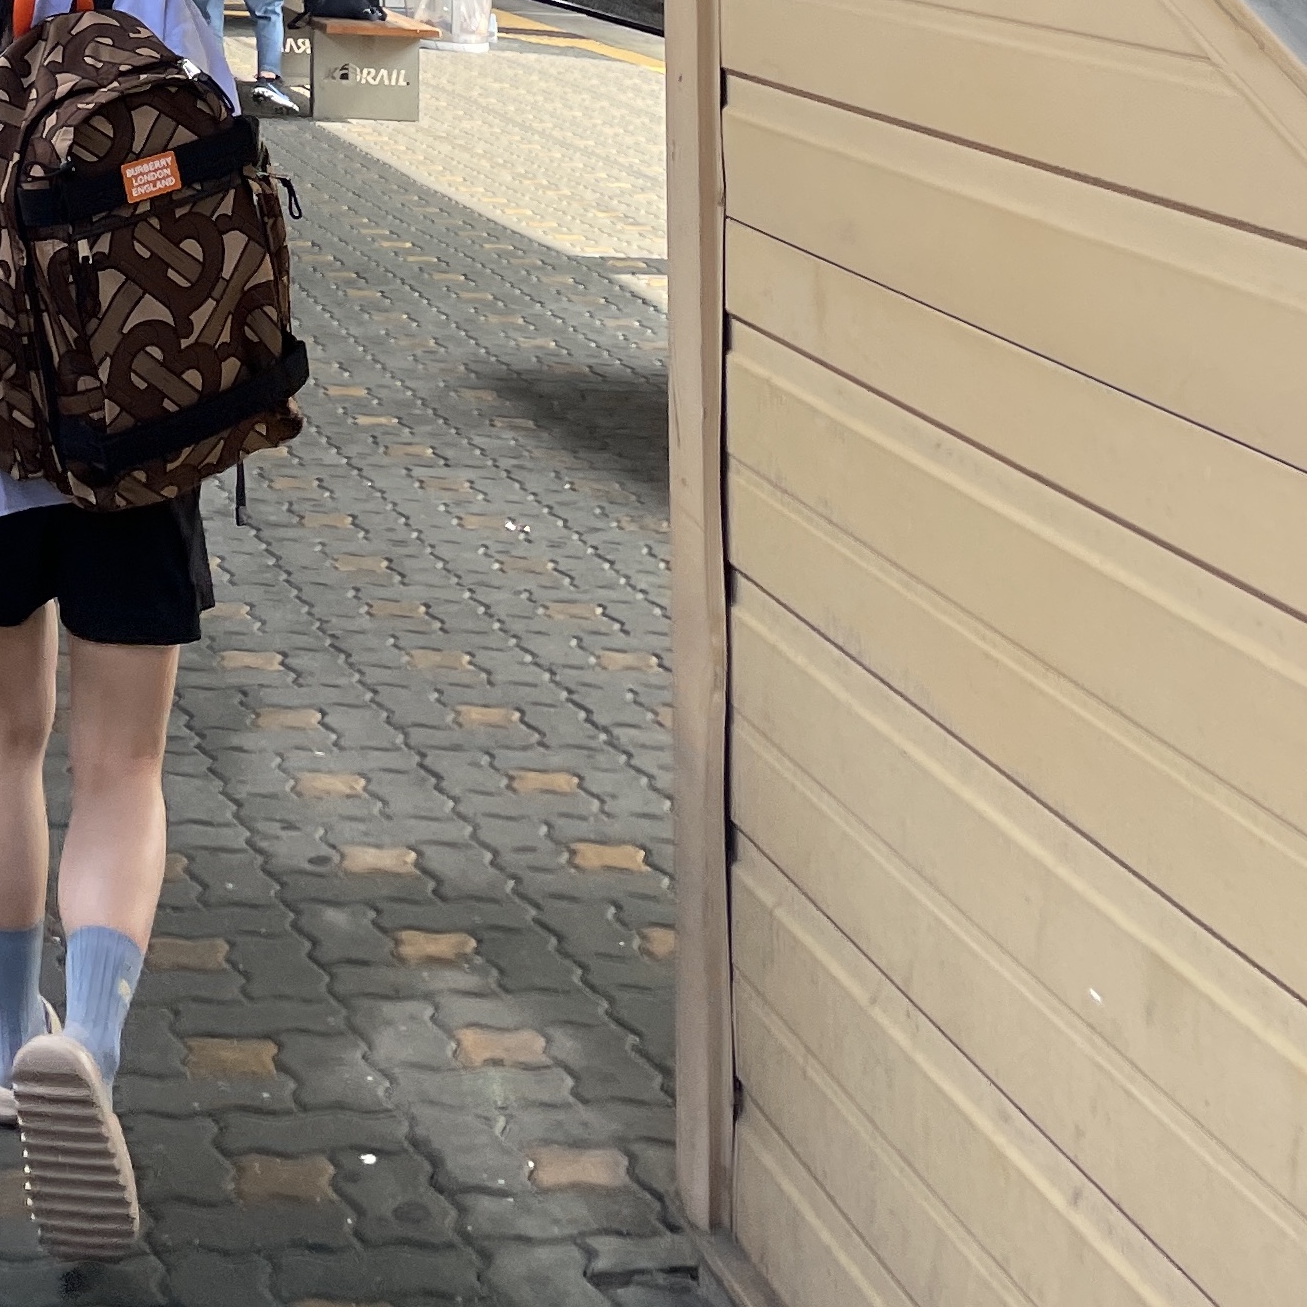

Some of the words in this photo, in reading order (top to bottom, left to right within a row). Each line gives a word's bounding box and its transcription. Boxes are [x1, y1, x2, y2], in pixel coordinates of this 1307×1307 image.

[125, 156, 172, 178] BURBERRY
[132, 167, 172, 187] LONDON
[131, 176, 176, 197] ENGLAND
